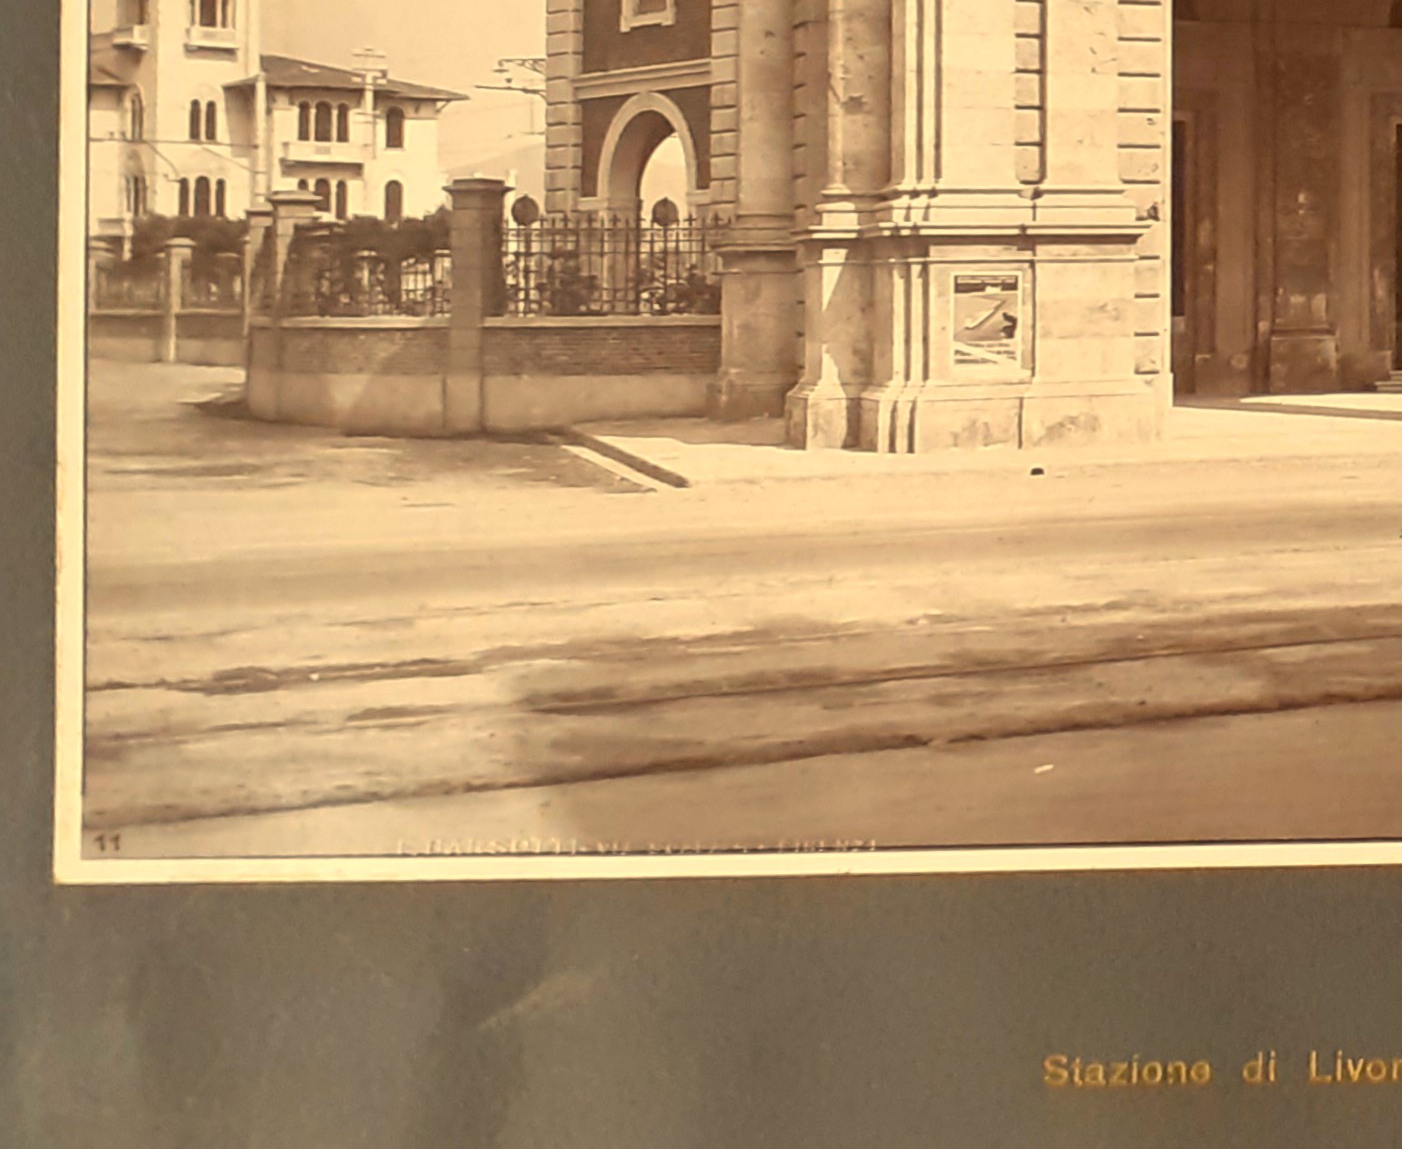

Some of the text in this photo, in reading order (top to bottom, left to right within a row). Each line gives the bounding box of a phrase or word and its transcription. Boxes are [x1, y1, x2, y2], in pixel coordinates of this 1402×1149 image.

[93, 833, 121, 851] 11
[1042, 1053, 1213, 1087] Stazione
[1242, 1050, 1277, 1084] di
